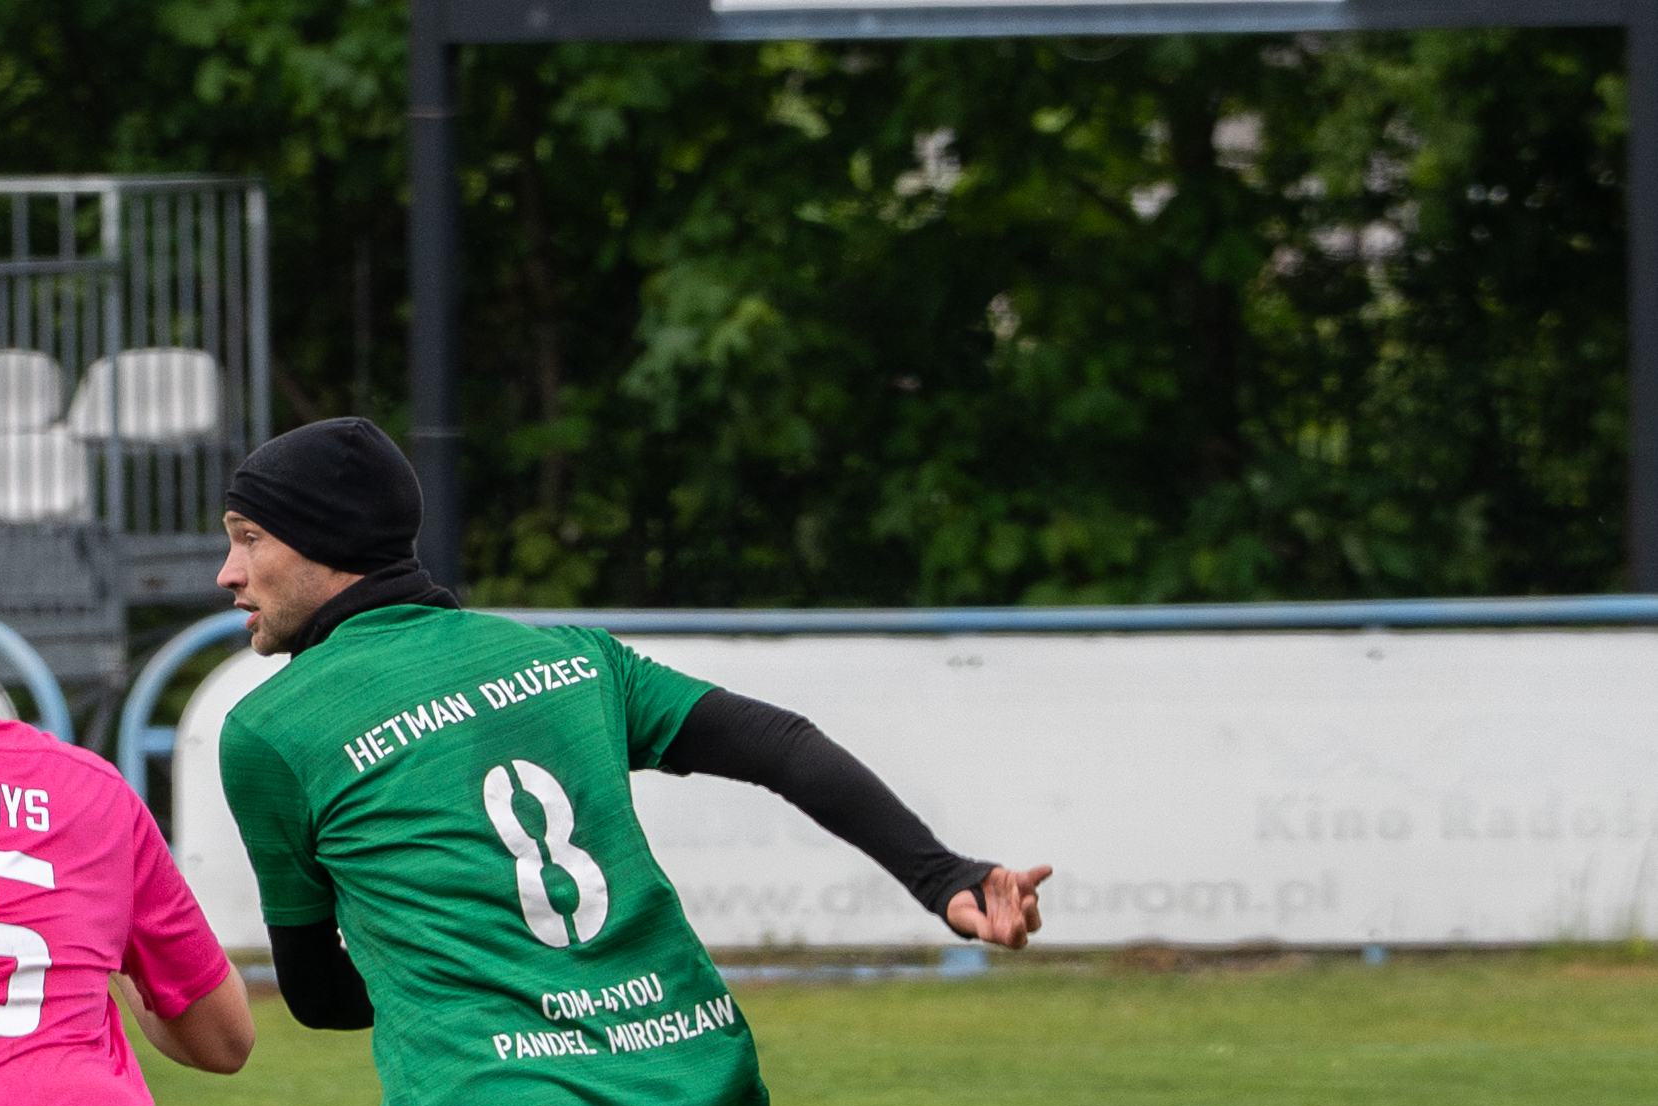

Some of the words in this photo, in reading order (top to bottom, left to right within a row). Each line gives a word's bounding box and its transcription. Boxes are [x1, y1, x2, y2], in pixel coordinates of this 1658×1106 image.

[343, 692, 477, 773] HETMAN
[479, 656, 598, 710] DŁUŻEC
[1254, 793, 1413, 841] Kino
[1440, 789, 1658, 841] Radoś
[483, 759, 609, 948] 8
[492, 1029, 598, 1060] PANDEL
[605, 994, 735, 1055] MIROSŁAW
[542, 972, 664, 1020] COM-4YOU
